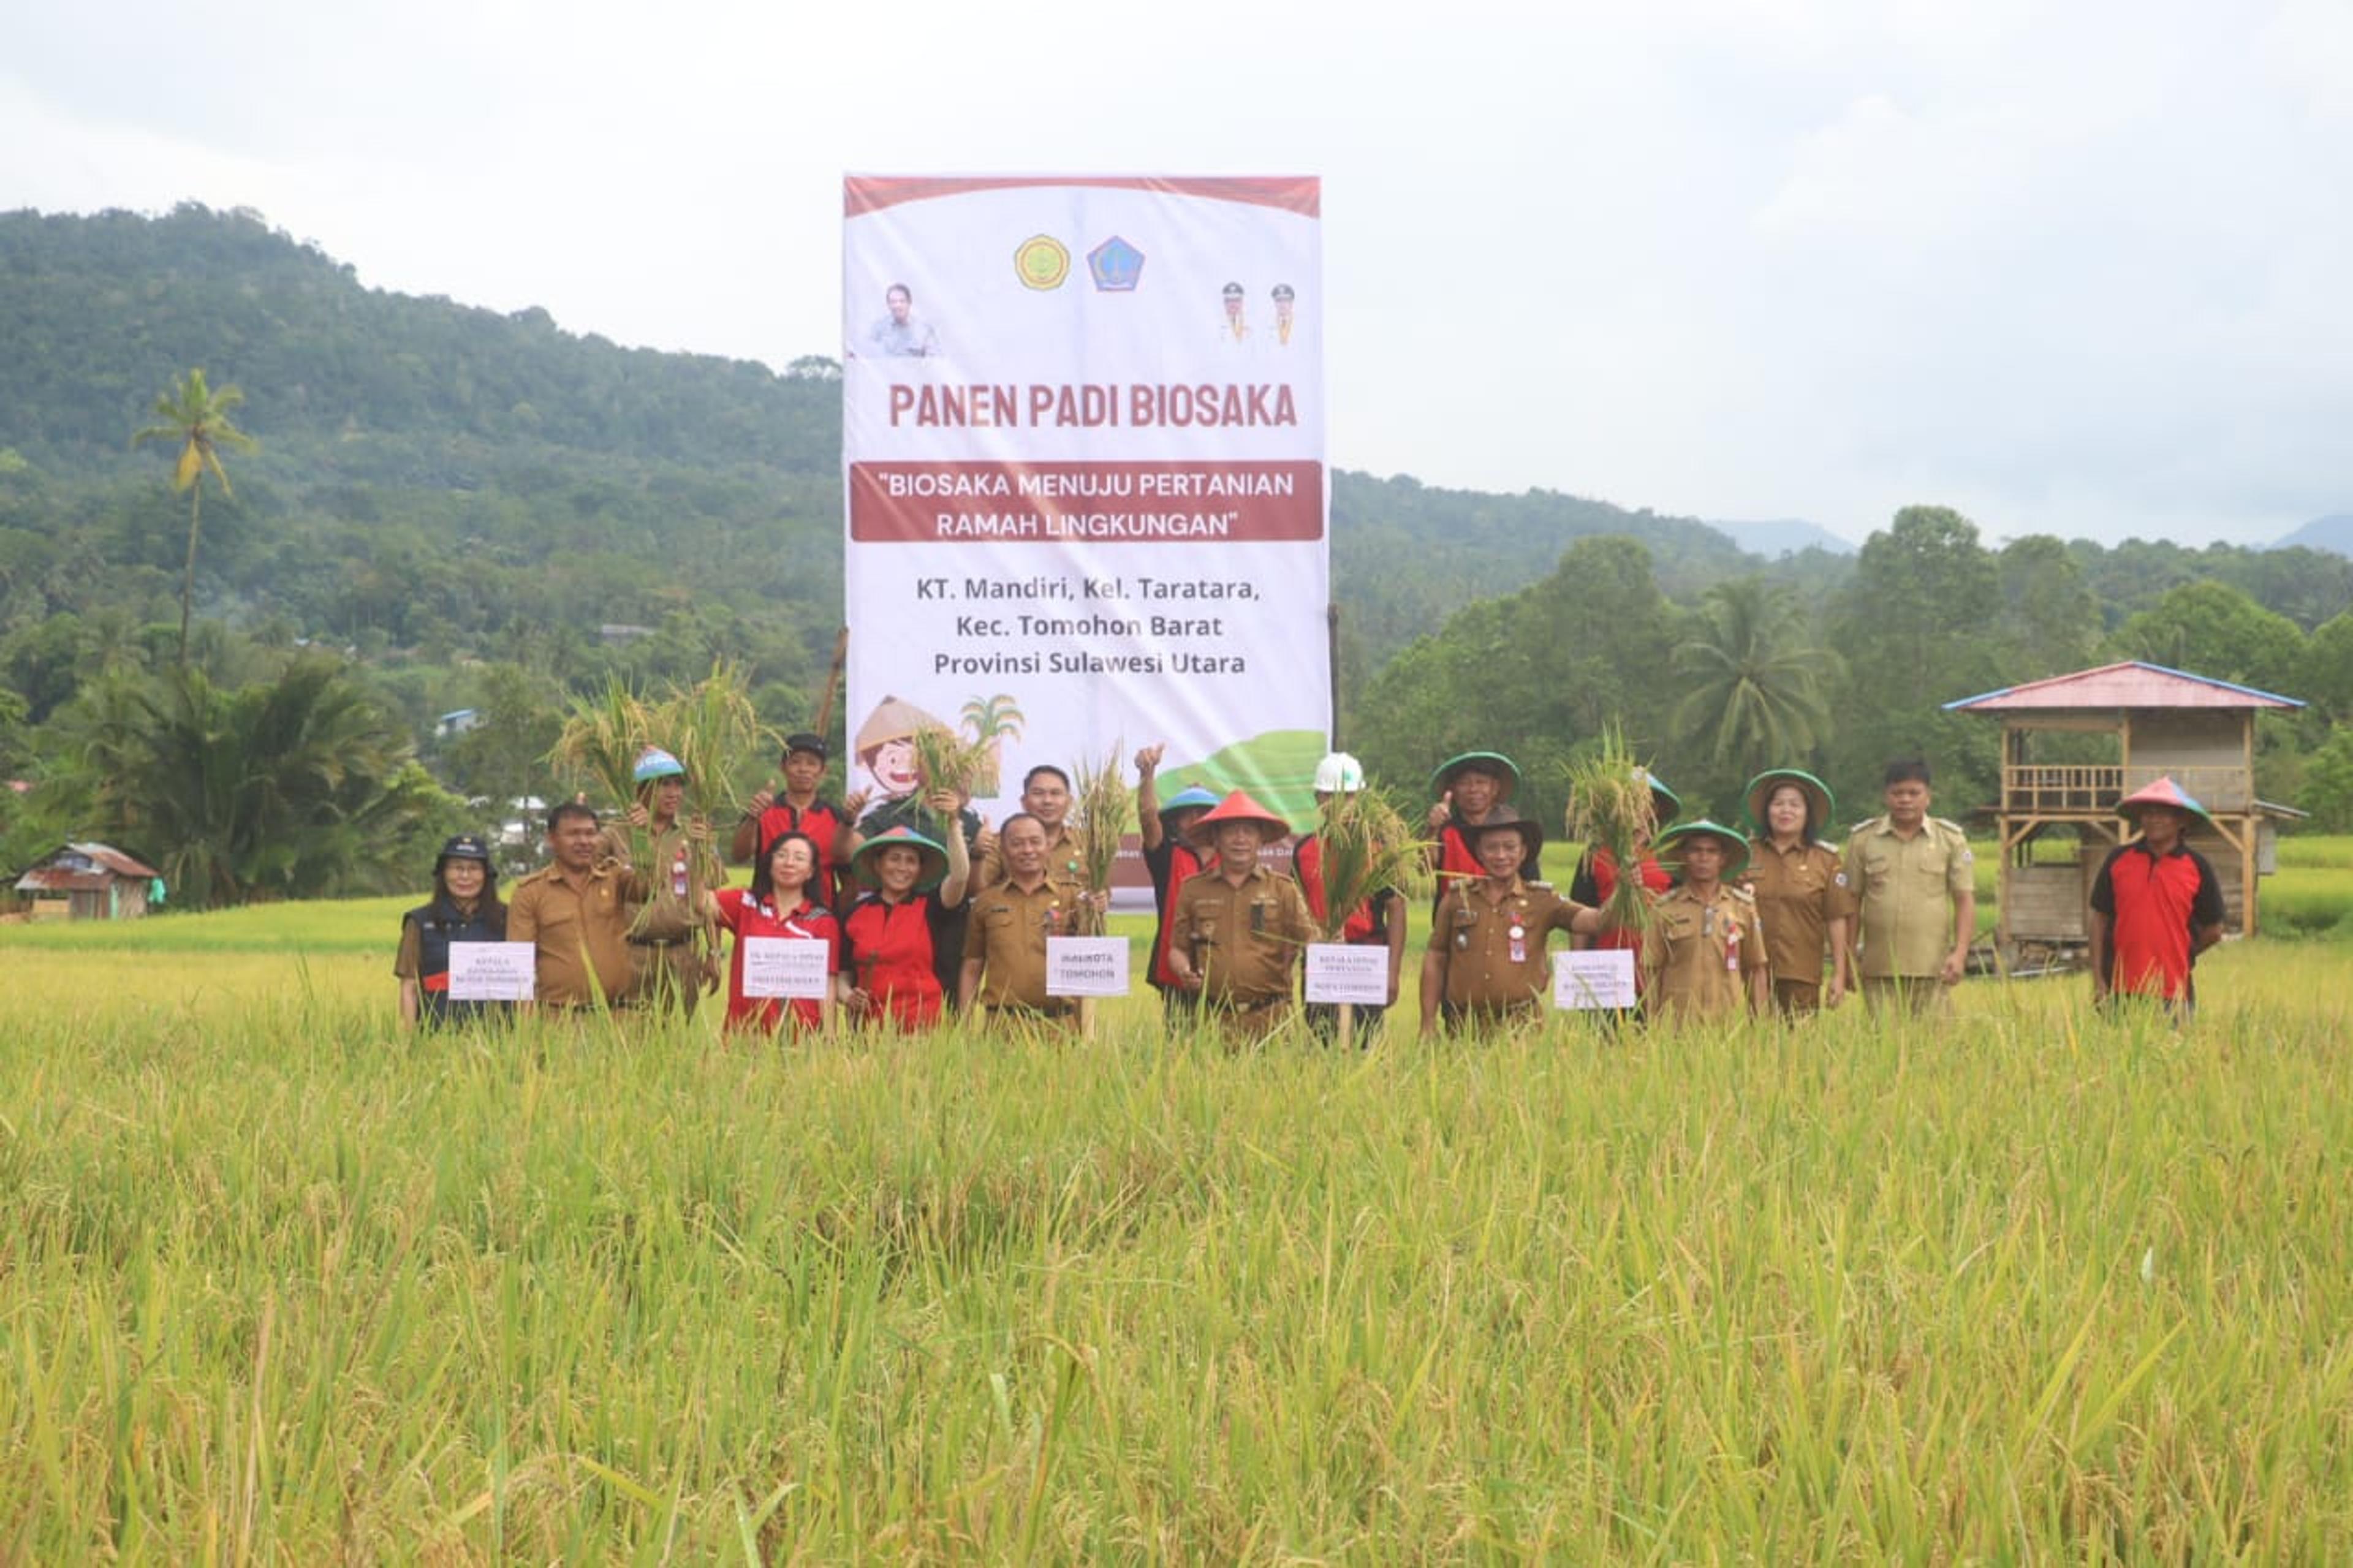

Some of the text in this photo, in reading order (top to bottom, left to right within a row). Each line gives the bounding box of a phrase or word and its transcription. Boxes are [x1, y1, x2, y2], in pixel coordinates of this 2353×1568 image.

[890, 384, 1297, 427] PANEN PADI BIOSAKA
[878, 472, 1294, 496] "BIOSAKA MENUJU PERTANIAN
[936, 512, 1238, 536] RAMAH LINGKUNGAN"
[917, 577, 1259, 601] KT. Mandiri, Kel. Taratara,
[957, 615, 1222, 636] Kec. Tomohon Barat
[935, 651, 1246, 674] Provinsi Sulawesi Utara
